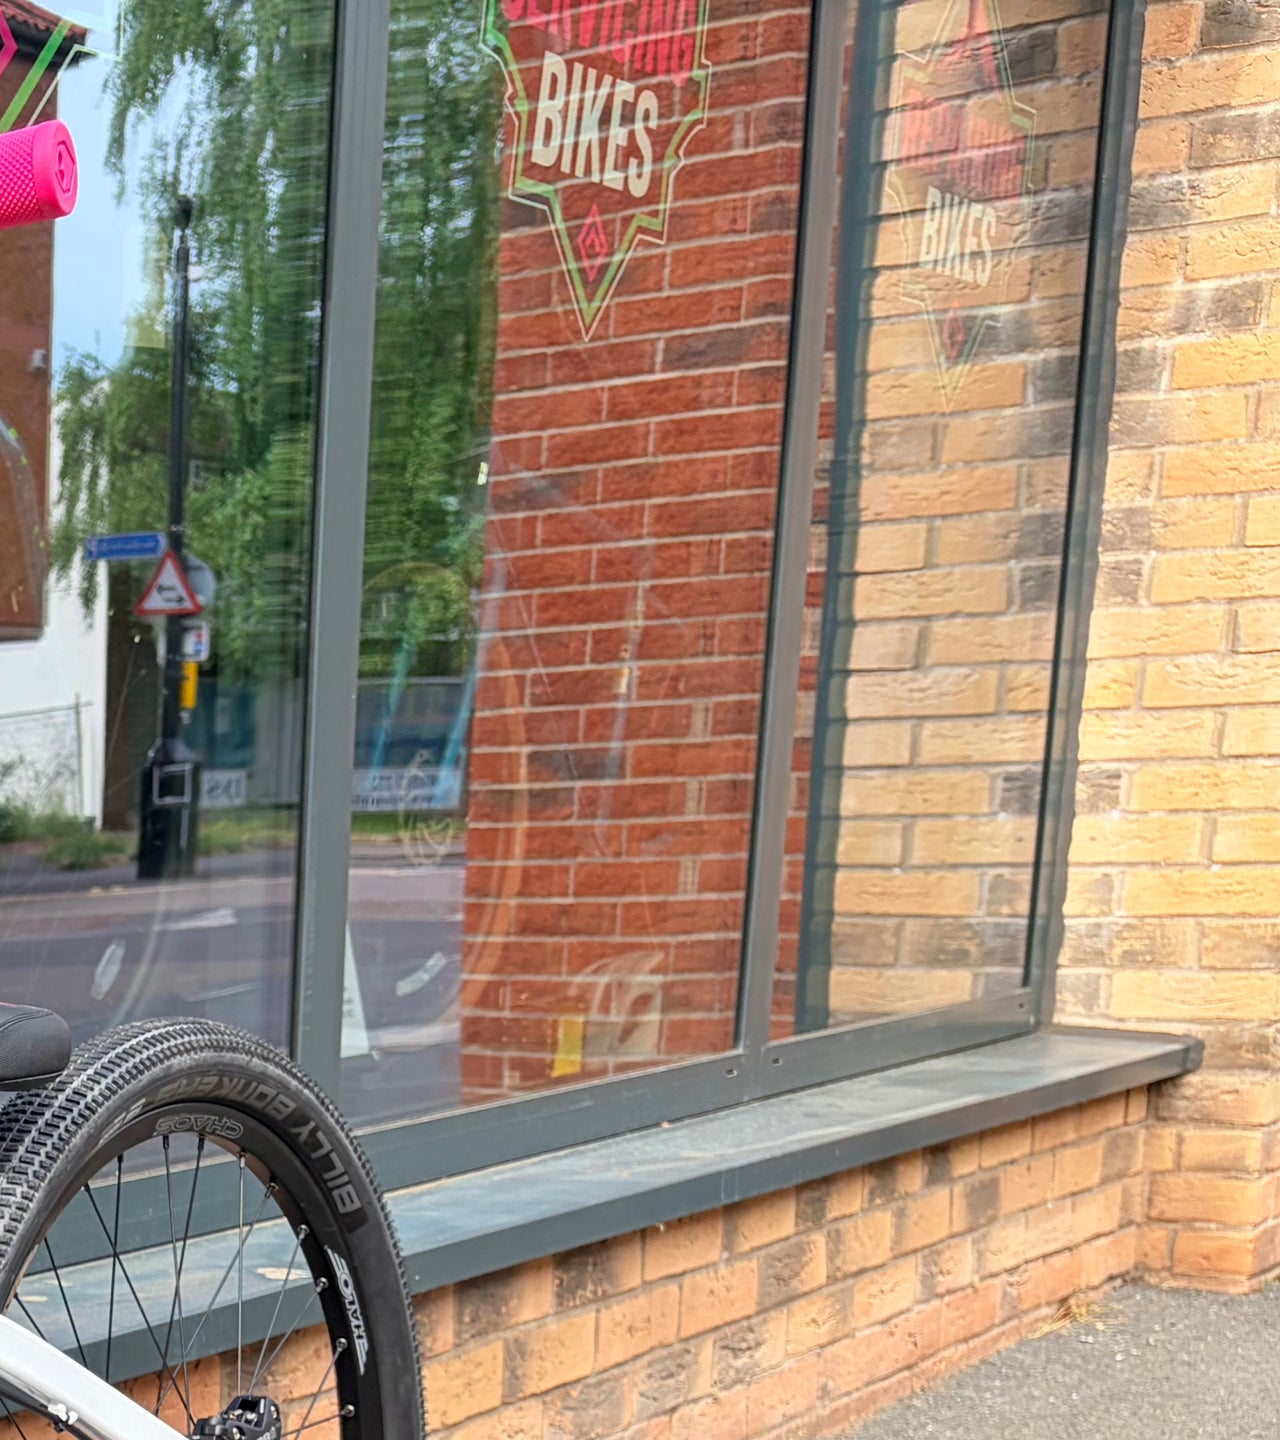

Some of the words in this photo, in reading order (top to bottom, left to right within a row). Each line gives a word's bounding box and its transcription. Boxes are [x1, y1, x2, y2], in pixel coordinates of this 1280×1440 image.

[531, 50, 659, 198] BIKES
[919, 186, 997, 287] BIKES
[154, 1112, 244, 1139] CHAOS
[294, 1120, 363, 1214] BILLY
